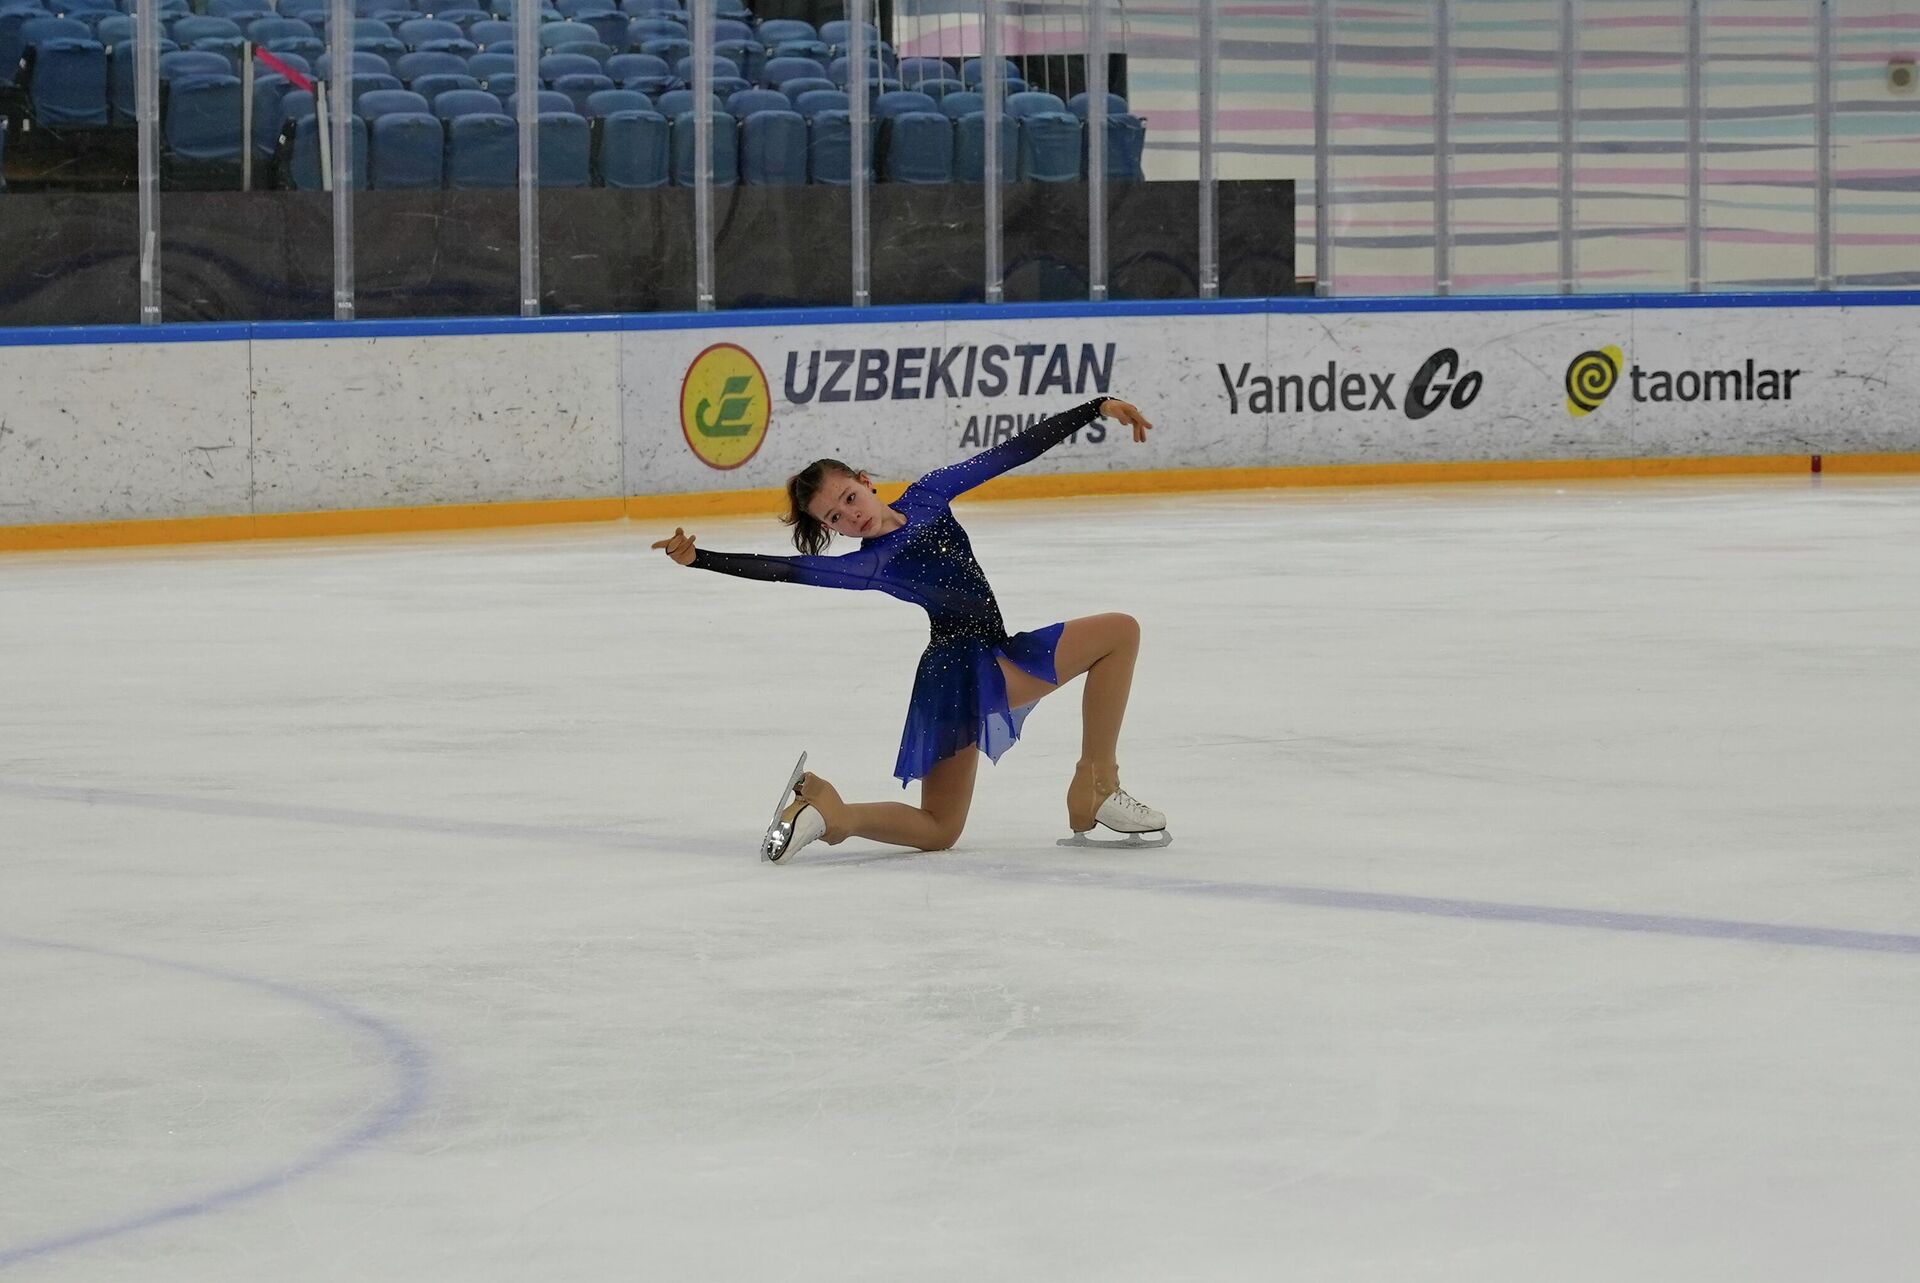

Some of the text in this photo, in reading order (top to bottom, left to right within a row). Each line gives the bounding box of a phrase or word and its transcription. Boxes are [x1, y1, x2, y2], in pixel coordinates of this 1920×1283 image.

[784, 343, 1116, 404] UZBEKISTAN
[1216, 348, 1483, 420] Yandex Go
[1630, 358, 1801, 402] taomlar
[959, 413, 1108, 448] AIRS
